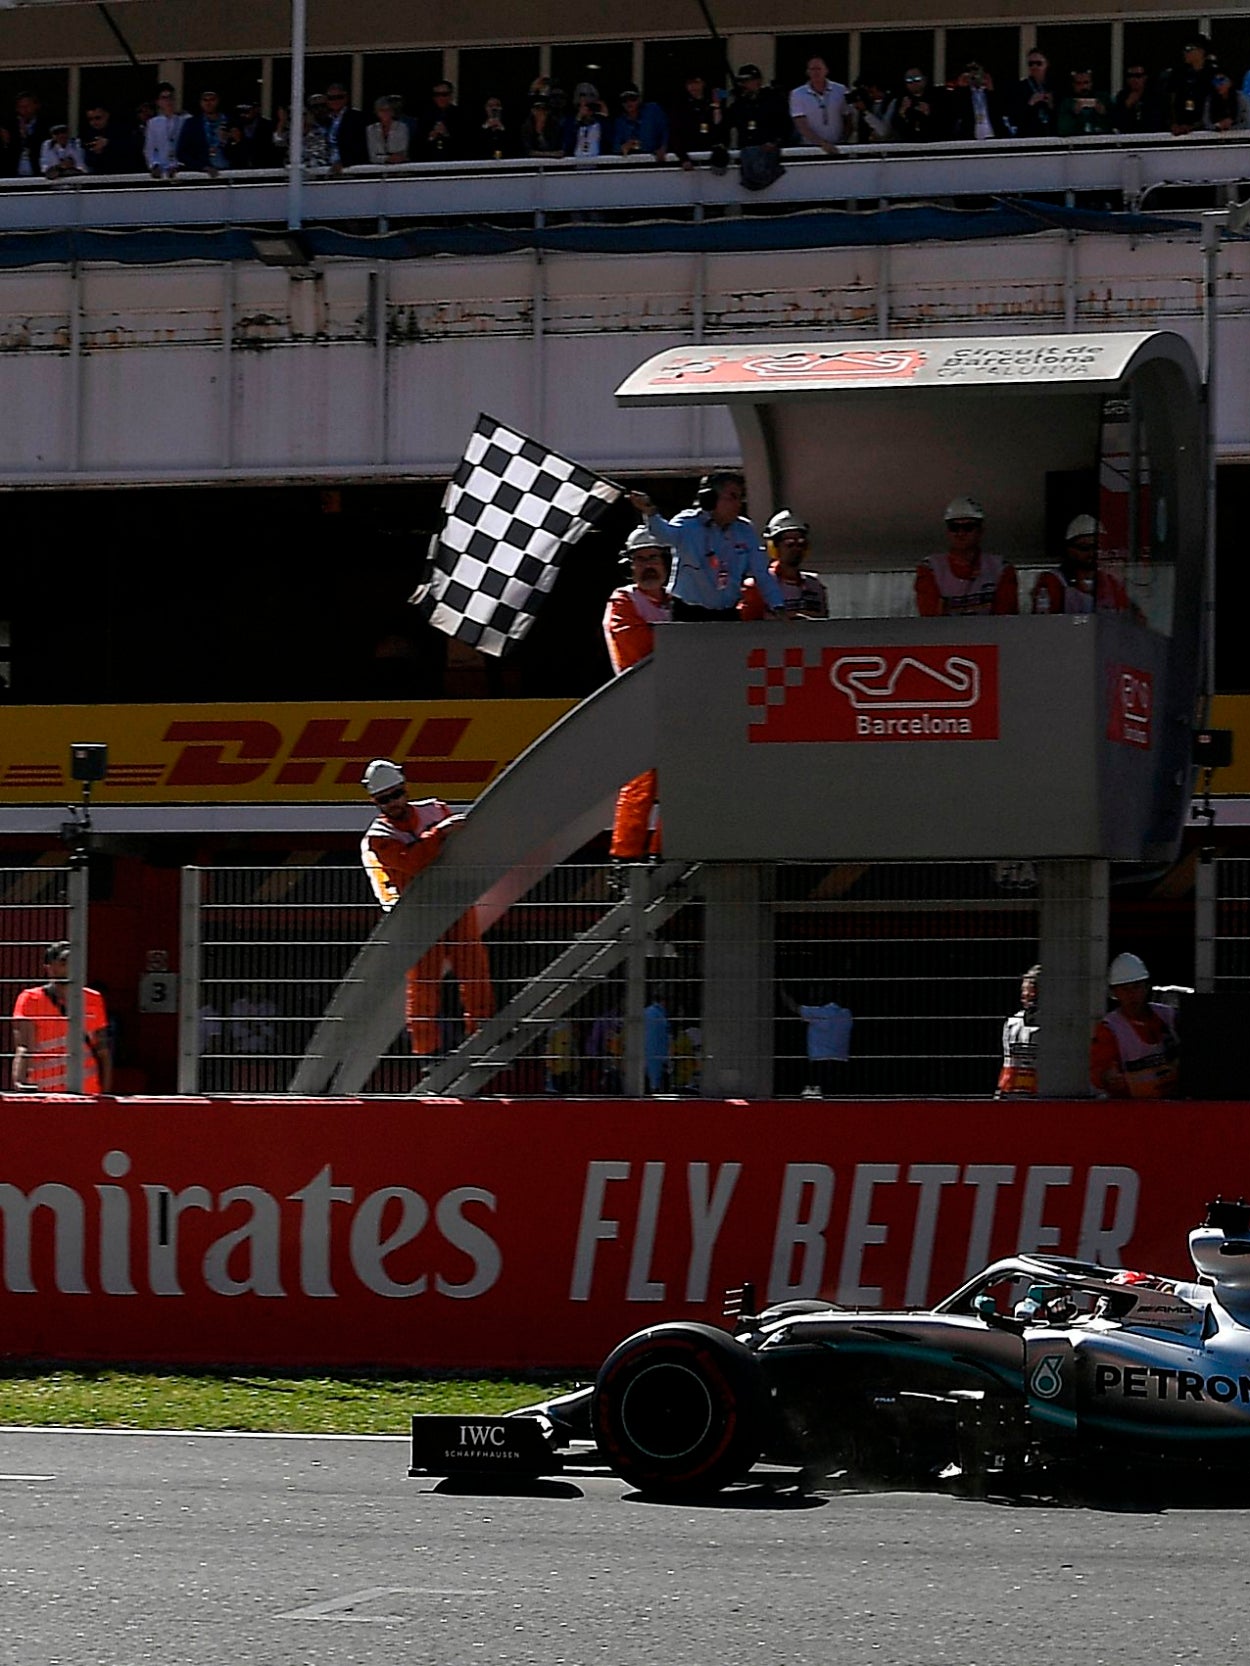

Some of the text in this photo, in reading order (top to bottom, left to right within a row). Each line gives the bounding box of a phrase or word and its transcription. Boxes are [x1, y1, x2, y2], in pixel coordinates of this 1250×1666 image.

[856, 714, 972, 735] Barcelona
[162, 717, 497, 786] DHL
[151, 982, 167, 1003] 3
[570, 1161, 742, 1302] FLY
[766, 1163, 1140, 1306] BETTER
[458, 1426, 505, 1446] IWC
[444, 1449, 520, 1459] SCHAFFHAUSEN
